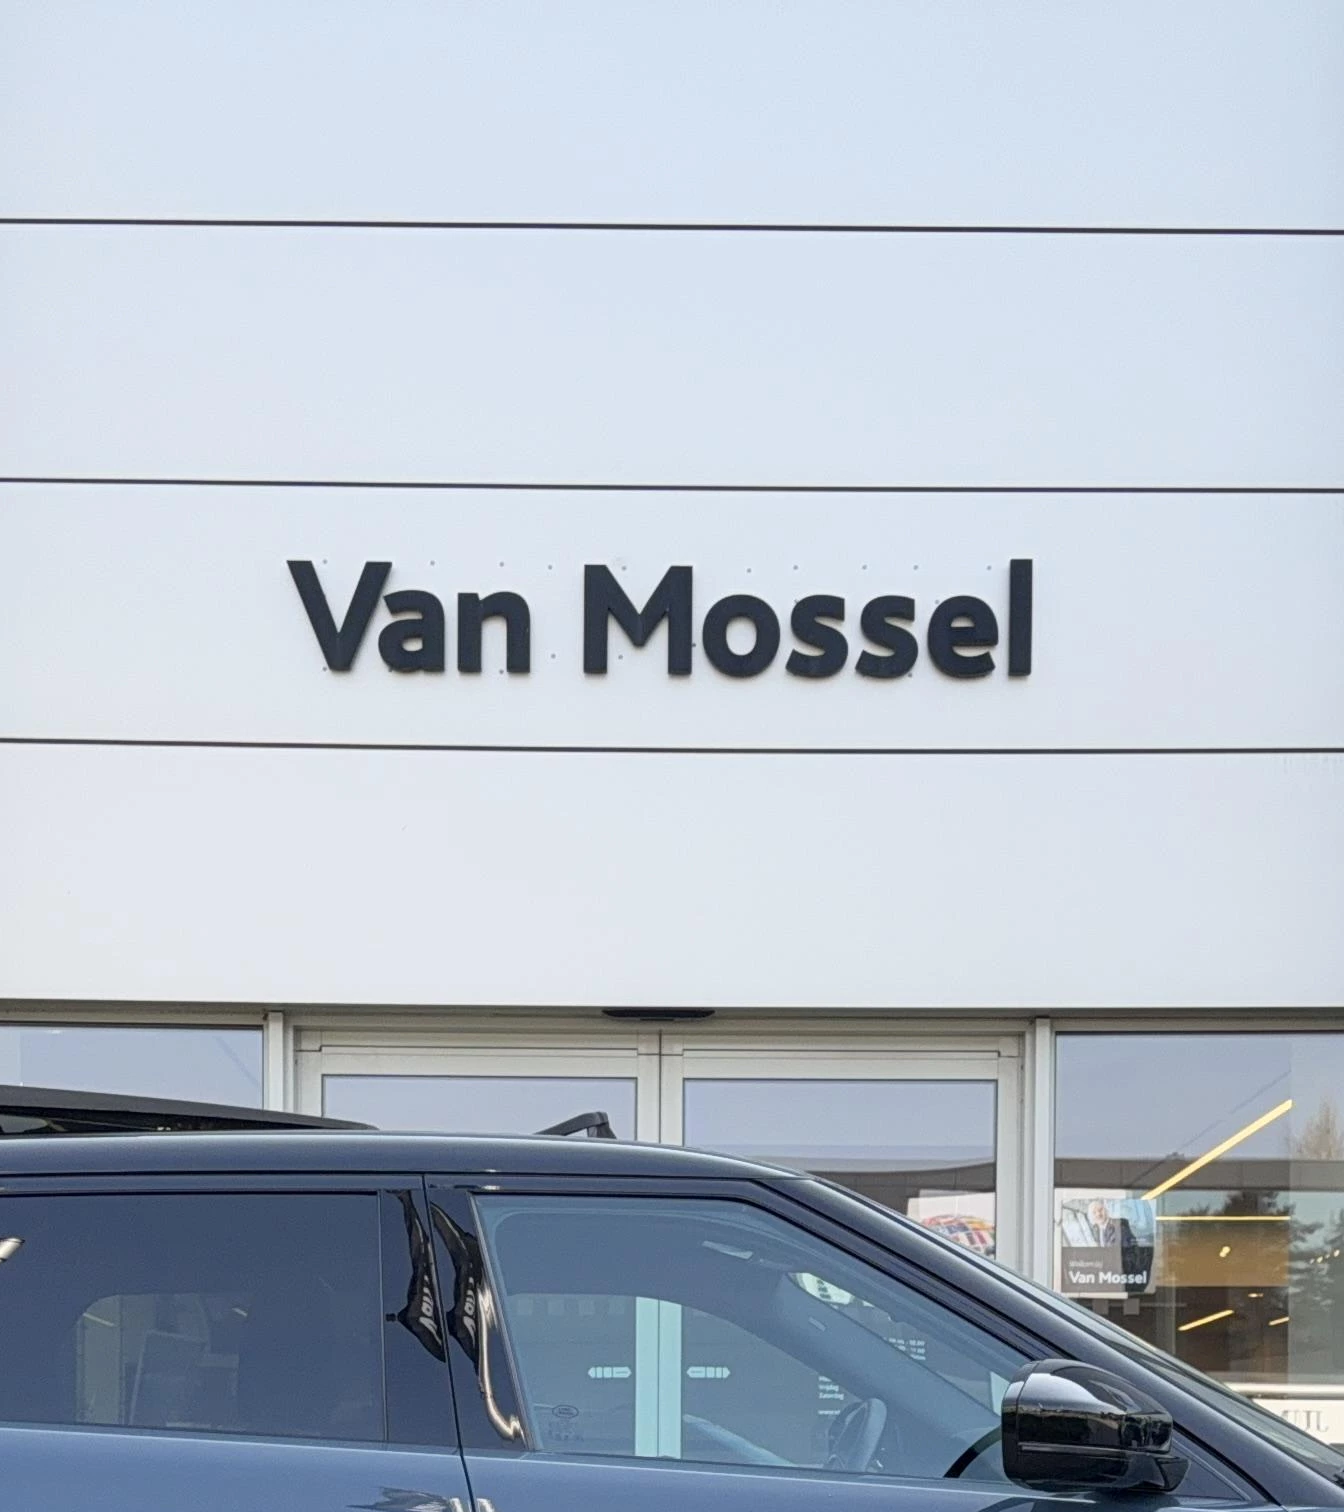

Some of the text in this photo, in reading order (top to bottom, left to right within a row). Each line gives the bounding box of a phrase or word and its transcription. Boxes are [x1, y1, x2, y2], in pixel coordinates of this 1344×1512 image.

[286, 558, 1033, 678] Van Mossel
[1068, 1270, 1147, 1284] Van Mossel
